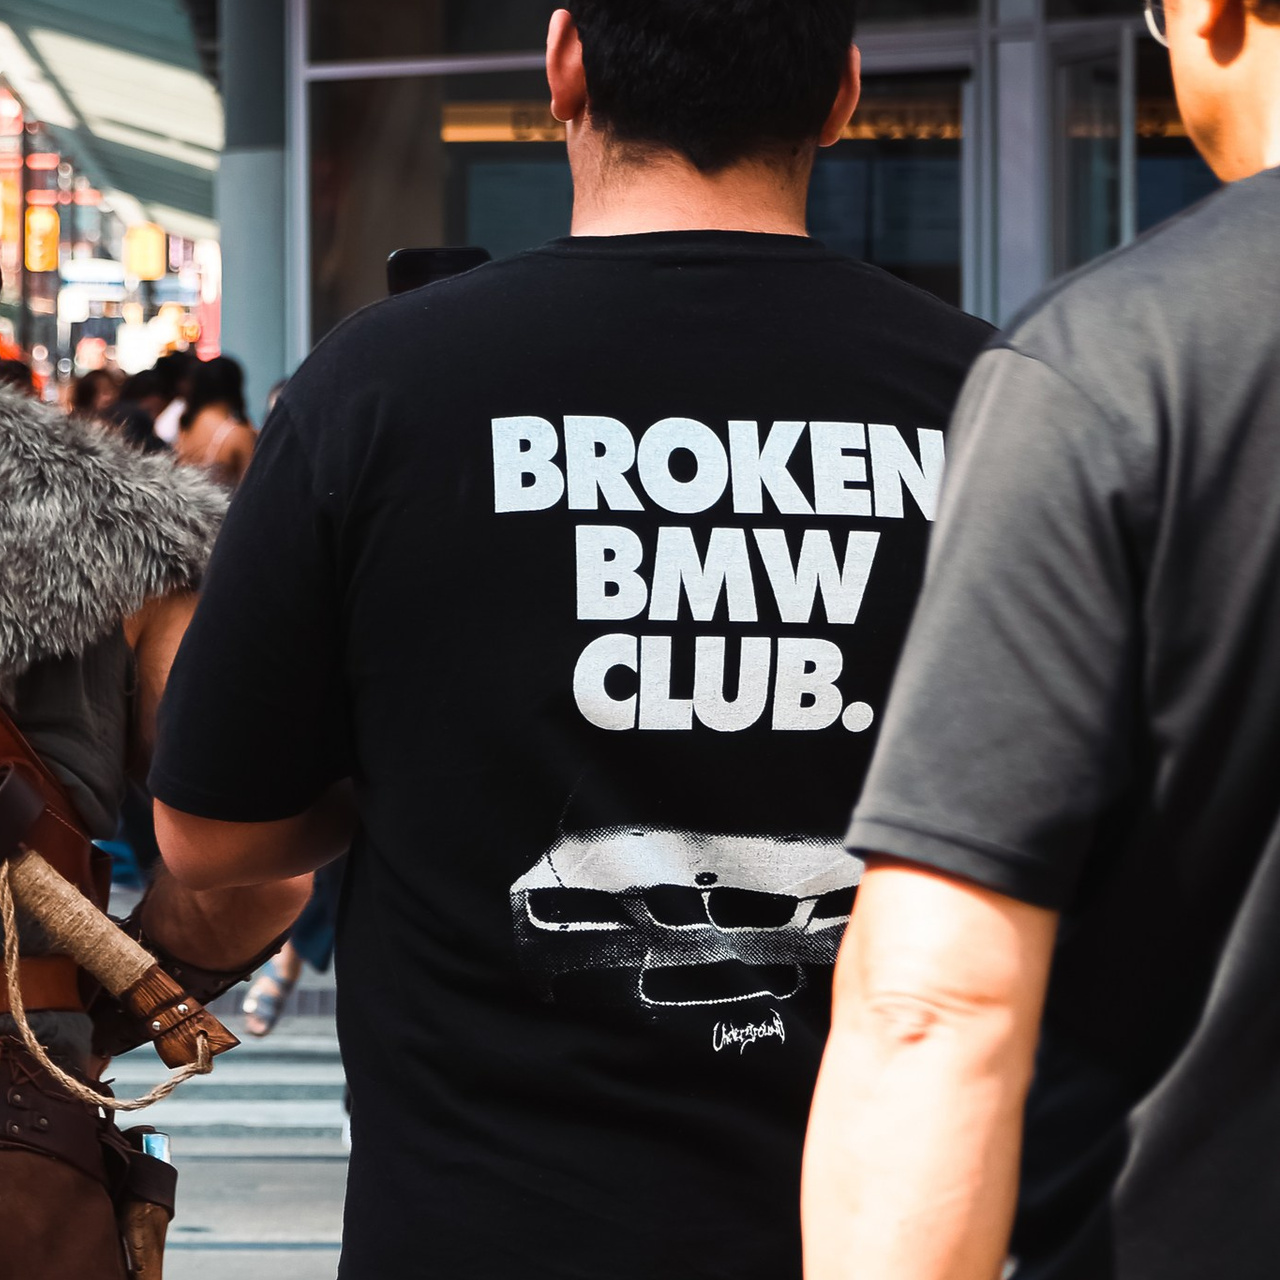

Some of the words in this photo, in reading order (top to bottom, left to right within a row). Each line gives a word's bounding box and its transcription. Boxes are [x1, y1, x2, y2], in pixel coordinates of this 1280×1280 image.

[491, 415, 945, 523] BROKEN
[576, 525, 881, 625] BMW
[573, 633, 874, 733] CLUB.
